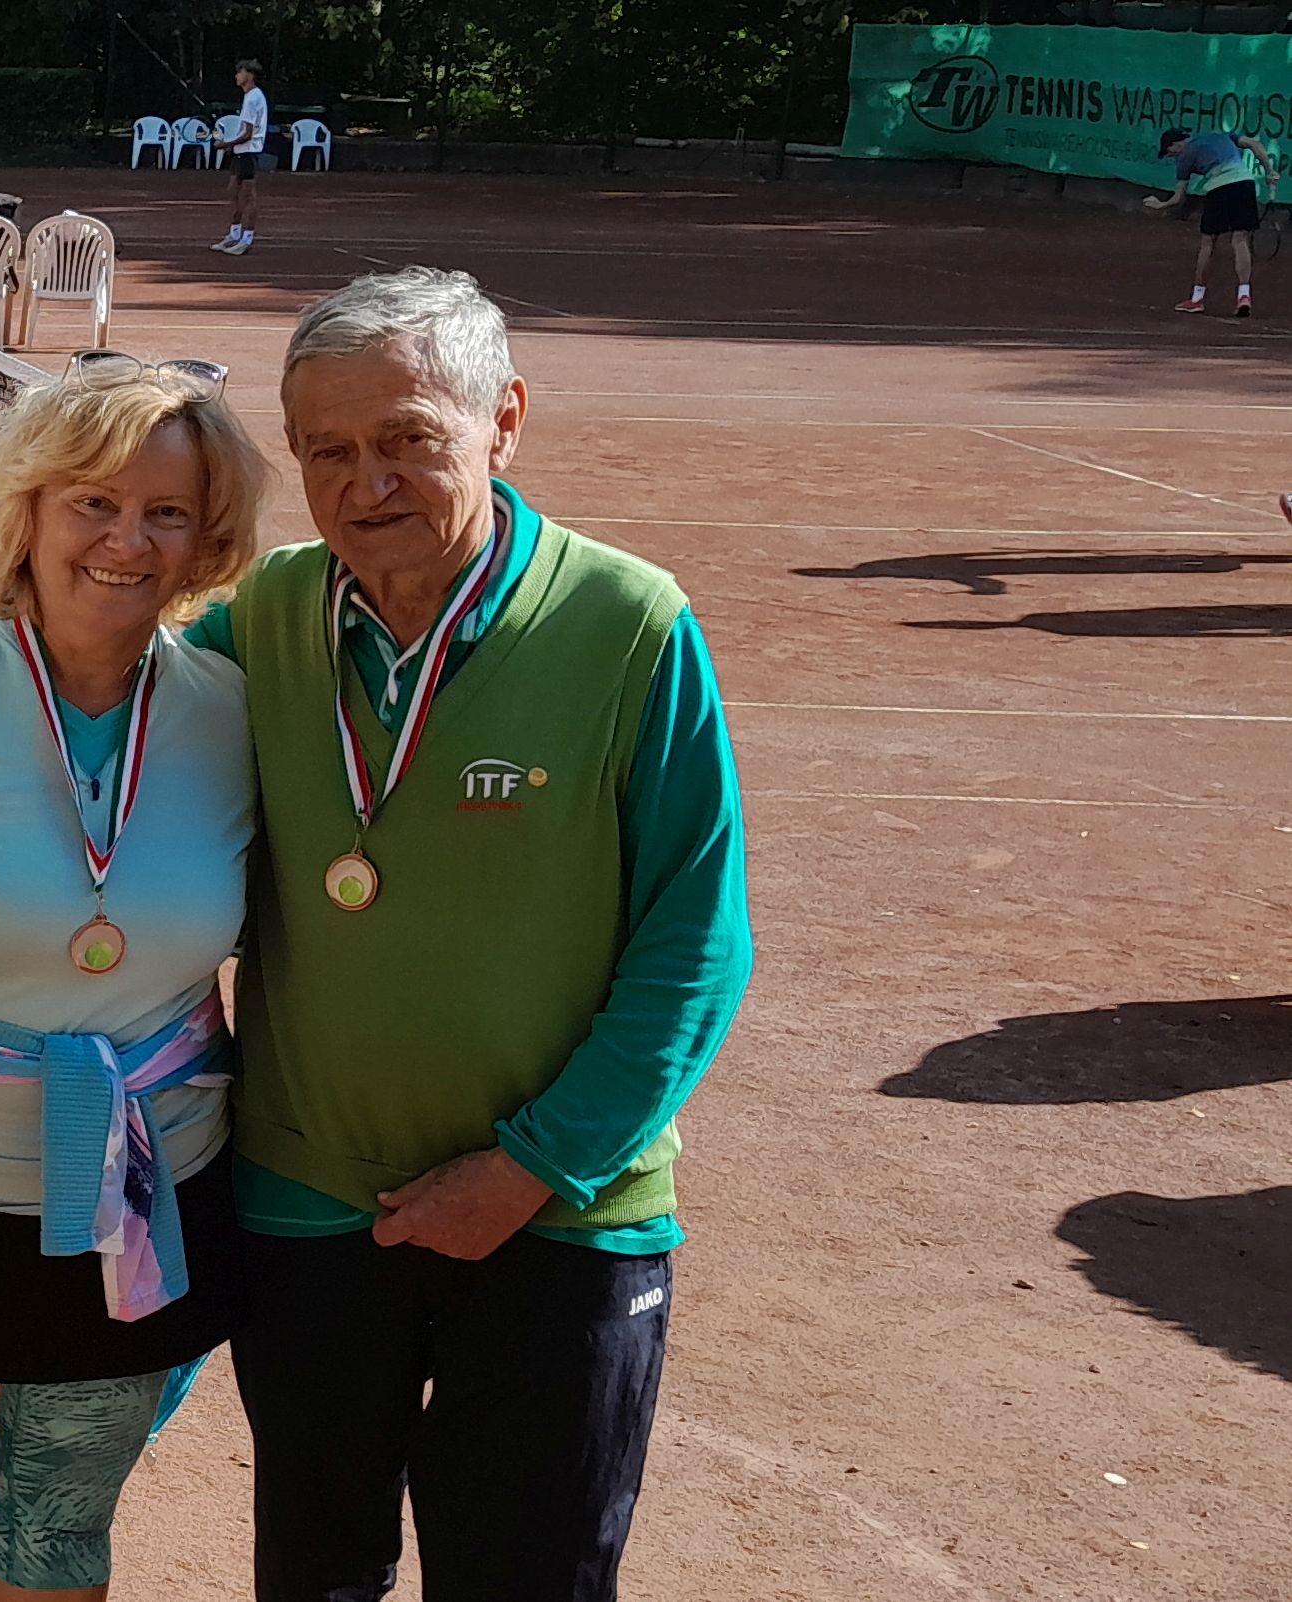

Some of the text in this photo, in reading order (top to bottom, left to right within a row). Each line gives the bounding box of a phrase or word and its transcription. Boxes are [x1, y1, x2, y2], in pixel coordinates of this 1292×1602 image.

[1005, 75, 1104, 123] TENNIS
[465, 772, 522, 799] ITF
[628, 1287, 664, 1317] JAKO
